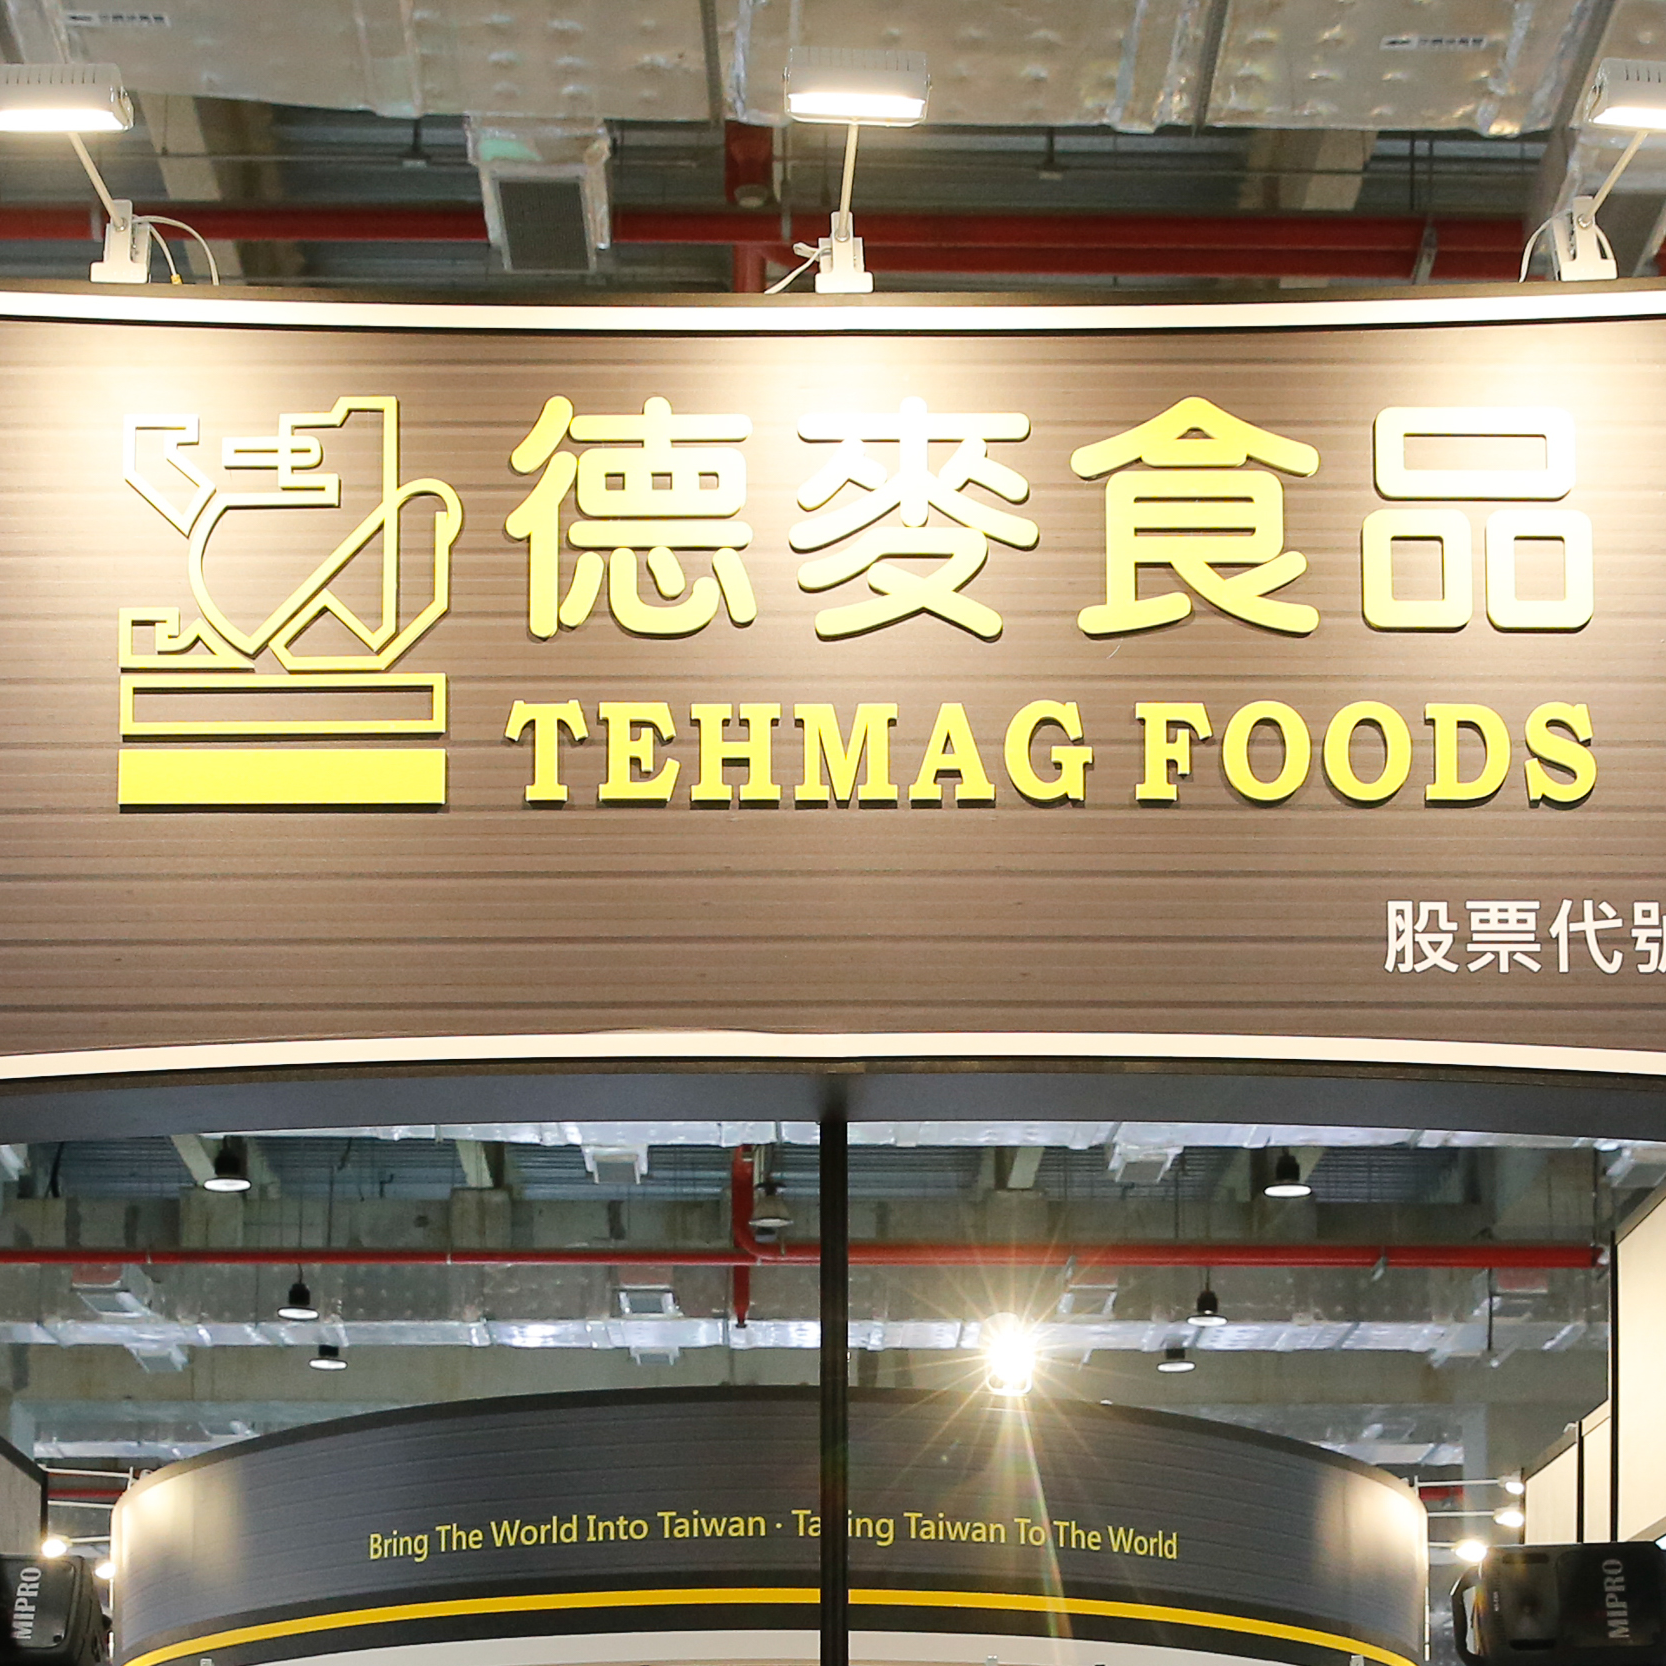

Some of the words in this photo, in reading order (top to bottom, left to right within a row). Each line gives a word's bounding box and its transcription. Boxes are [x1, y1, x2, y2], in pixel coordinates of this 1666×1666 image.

[504, 394, 1595, 643] 德麥食品
[504, 698, 1095, 807] TEHMAG
[1134, 700, 1599, 806] FOODS
[368, 1532, 429, 1562] Bring
[436, 1523, 483, 1552] The
[489, 1514, 579, 1547] World
[587, 1513, 649, 1544] Into
[656, 1509, 767, 1540] Taiwan
[791, 1508, 896, 1546] Taing
[903, 1512, 1007, 1544] Taiwan
[1013, 1515, 1047, 1547] To
[1052, 1520, 1103, 1553] The
[1107, 1525, 1178, 1560] World
[14, 1565, 43, 1641] MIPRO
[1607, 1556, 1624, 1646] MIPRO
